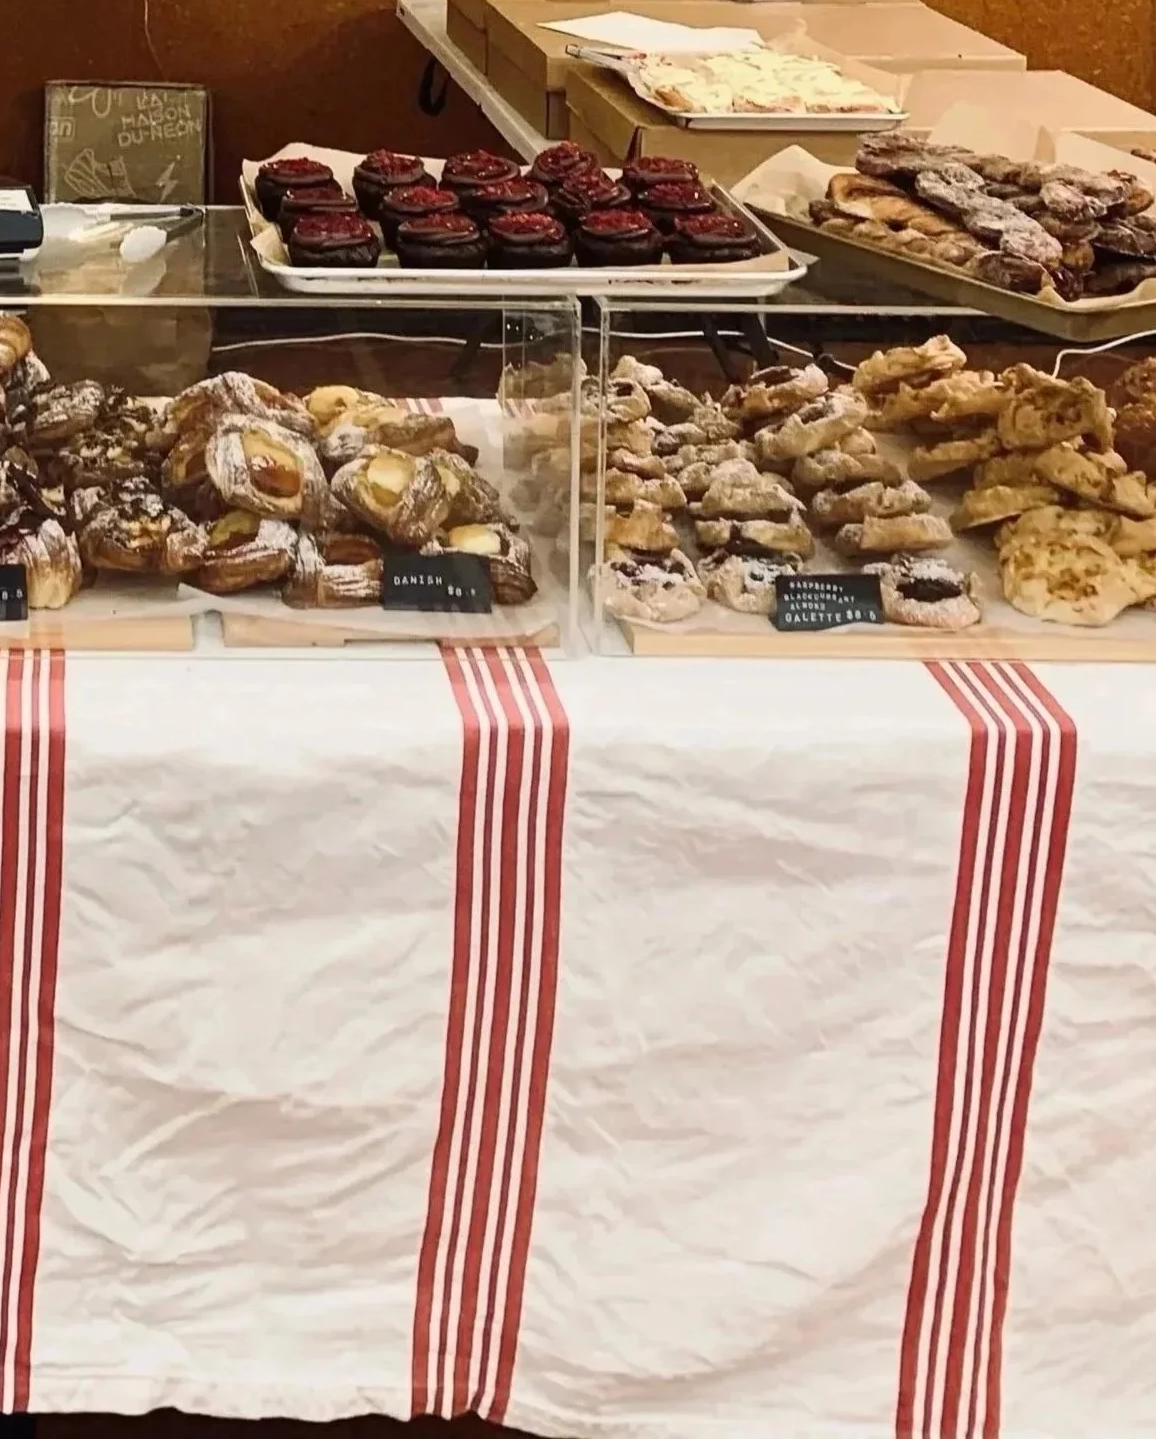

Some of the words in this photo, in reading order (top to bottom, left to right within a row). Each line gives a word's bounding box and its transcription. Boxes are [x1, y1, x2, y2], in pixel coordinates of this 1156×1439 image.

[393, 574, 443, 586] DANISH
[790, 602, 826, 611] ALMOND
[785, 611, 843, 623] GALETTE
